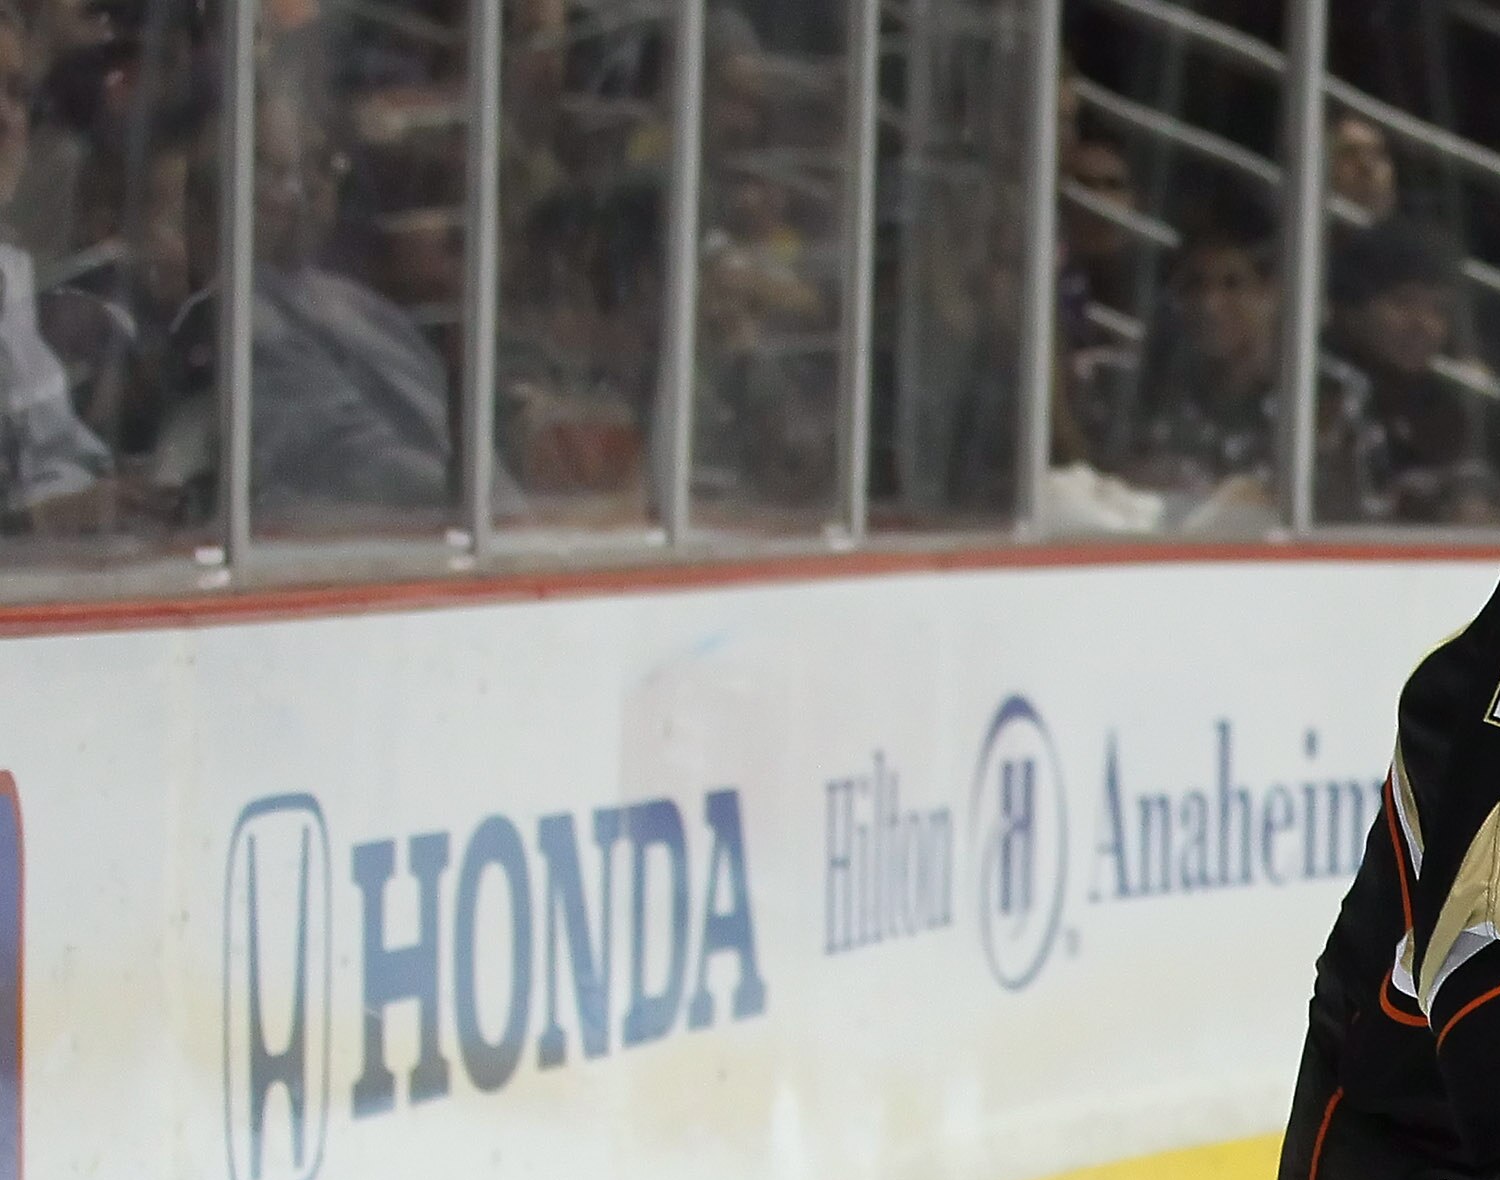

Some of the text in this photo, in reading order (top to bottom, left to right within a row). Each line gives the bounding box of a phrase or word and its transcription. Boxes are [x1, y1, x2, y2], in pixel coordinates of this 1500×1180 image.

[350, 787, 767, 1121] HONDA
[824, 748, 953, 955] Hilton
[1088, 716, 1386, 903] Anaheim
